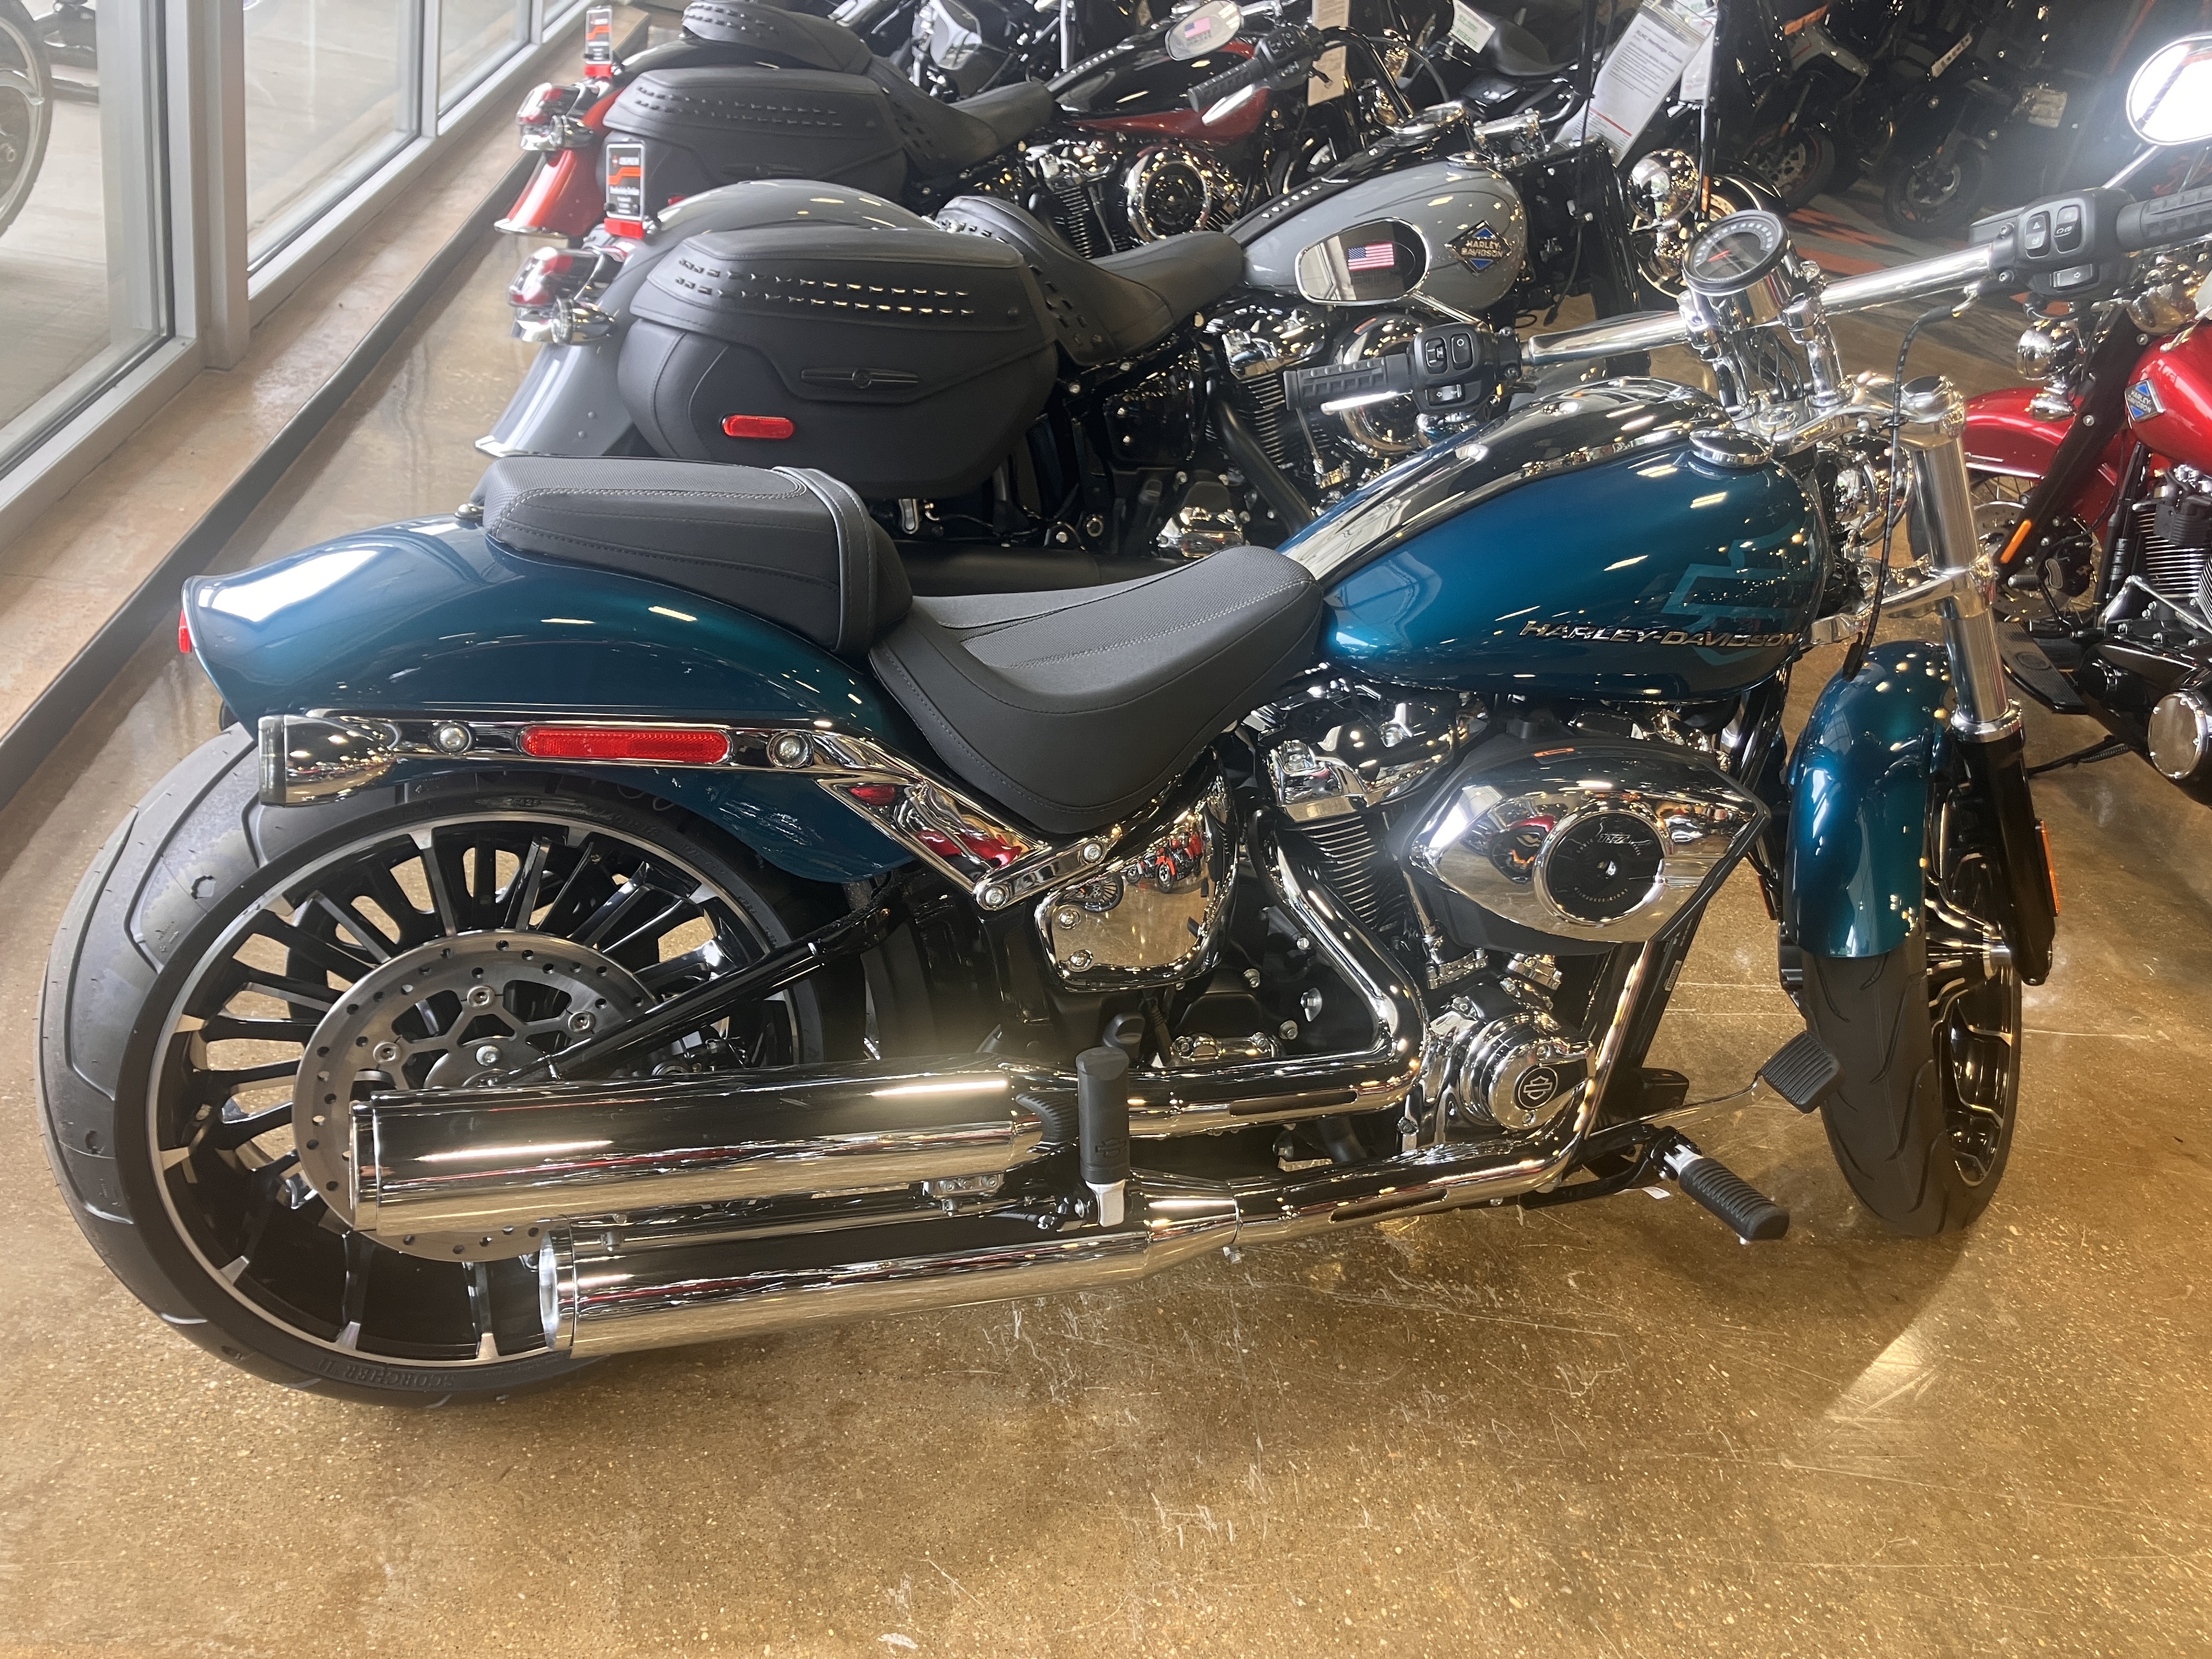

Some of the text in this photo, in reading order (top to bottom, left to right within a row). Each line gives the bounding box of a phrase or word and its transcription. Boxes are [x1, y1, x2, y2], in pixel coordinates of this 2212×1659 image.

[1460, 247, 1503, 258] DAVIDSON
[2127, 394, 2152, 413] DAVIDSON
[1519, 620, 1801, 648] HARLEY-DAVIDSON
[343, 1364, 455, 1389] SCORCHER
